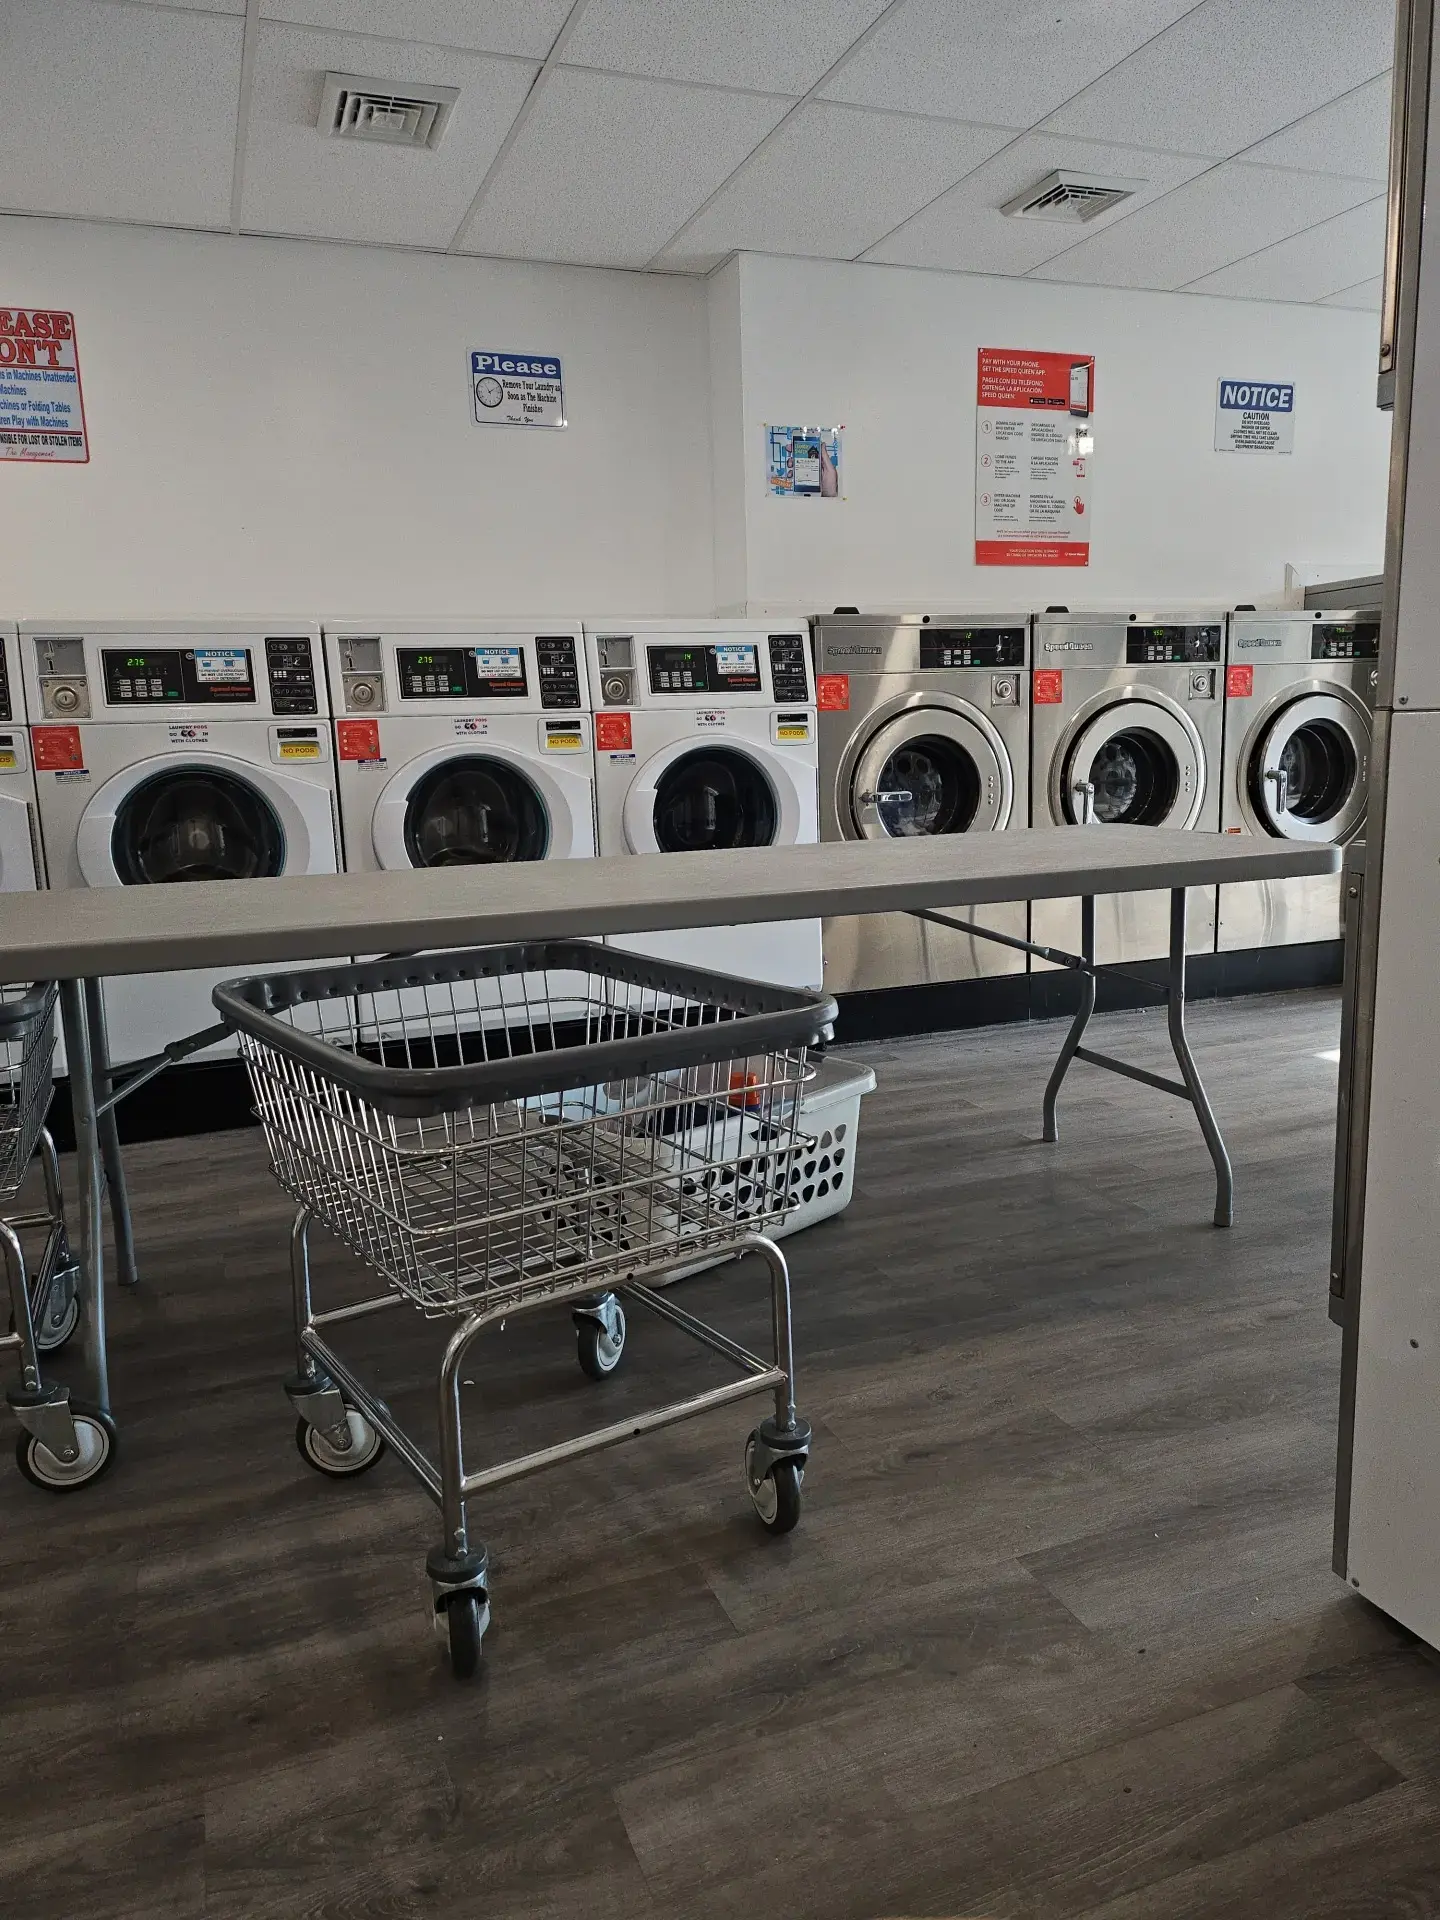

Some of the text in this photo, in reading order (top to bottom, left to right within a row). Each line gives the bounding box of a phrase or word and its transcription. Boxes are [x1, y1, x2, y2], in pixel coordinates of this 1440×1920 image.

[0, 311, 71, 339] EASE
[0, 337, 62, 365] ON'T
[475, 355, 557, 375] Please
[6, 369, 12, 380] in
[13, 369, 41, 381] Machines
[42, 371, 76, 383] Unattended
[502, 379, 521, 390] Remove
[522, 380, 533, 390] Your
[535, 382, 554, 394] Laundry
[508, 391, 520, 400] Soon
[527, 392, 536, 401] The
[537, 393, 556, 402] Machine
[1223, 385, 1291, 407] NOTICE
[21, 403, 27, 411] or
[28, 400, 50, 414] Folding
[51, 402, 71, 413] Tables
[523, 404, 543, 413] Finishes
[0, 415, 68, 428] ren Play with Machines
[1243, 412, 1269, 420] CAUTION
[18, 434, 27, 445] FOR
[28, 434, 40, 446] LOST
[42, 436, 48, 446] OR
[49, 436, 67, 446] STOLEN
[68, 436, 82, 447] ITEMS
[20, 448, 54, 459] Management
[1044, 642, 1069, 652] Speed
